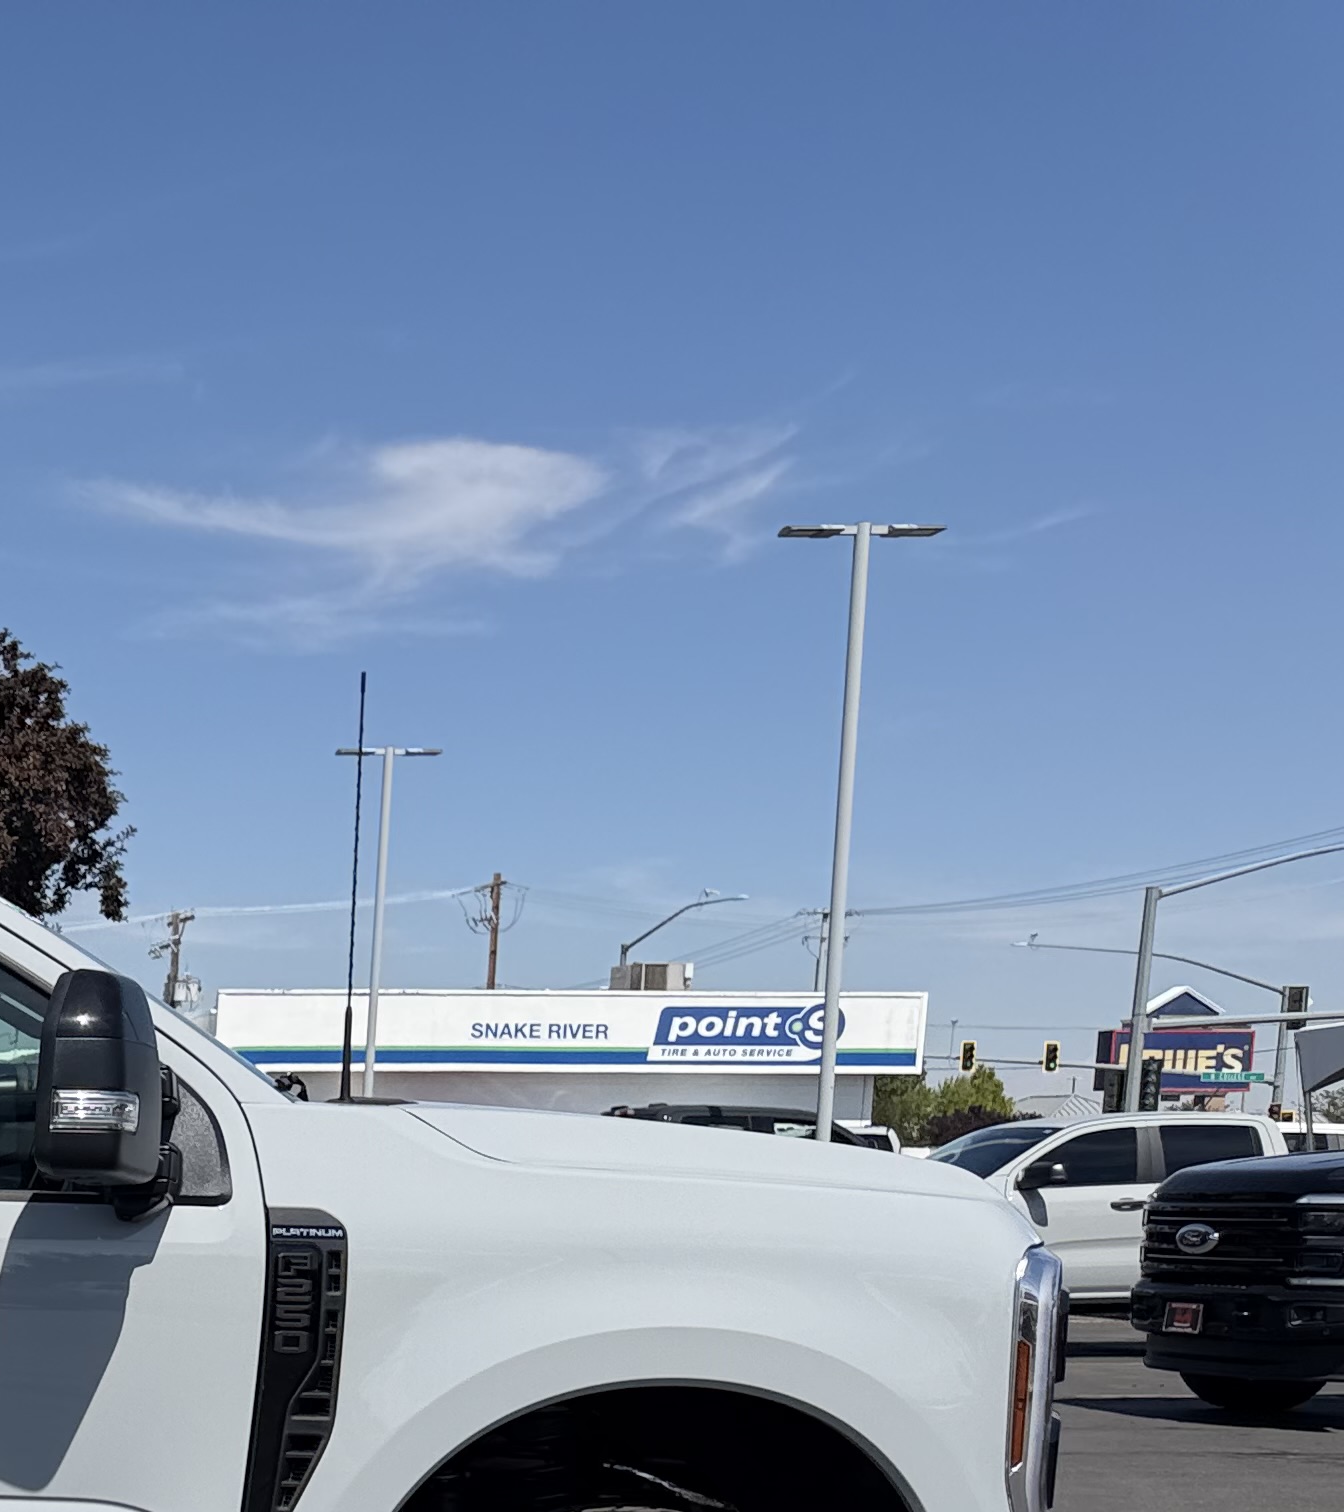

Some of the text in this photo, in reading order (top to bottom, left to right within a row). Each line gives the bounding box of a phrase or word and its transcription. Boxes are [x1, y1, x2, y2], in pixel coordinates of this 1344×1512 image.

[471, 1023, 609, 1040] SNAKE RIVER
[667, 1010, 781, 1042] point
[661, 1048, 793, 1057] TIRE & AUTO SERVICE
[272, 1226, 344, 1238] PLATINUM
